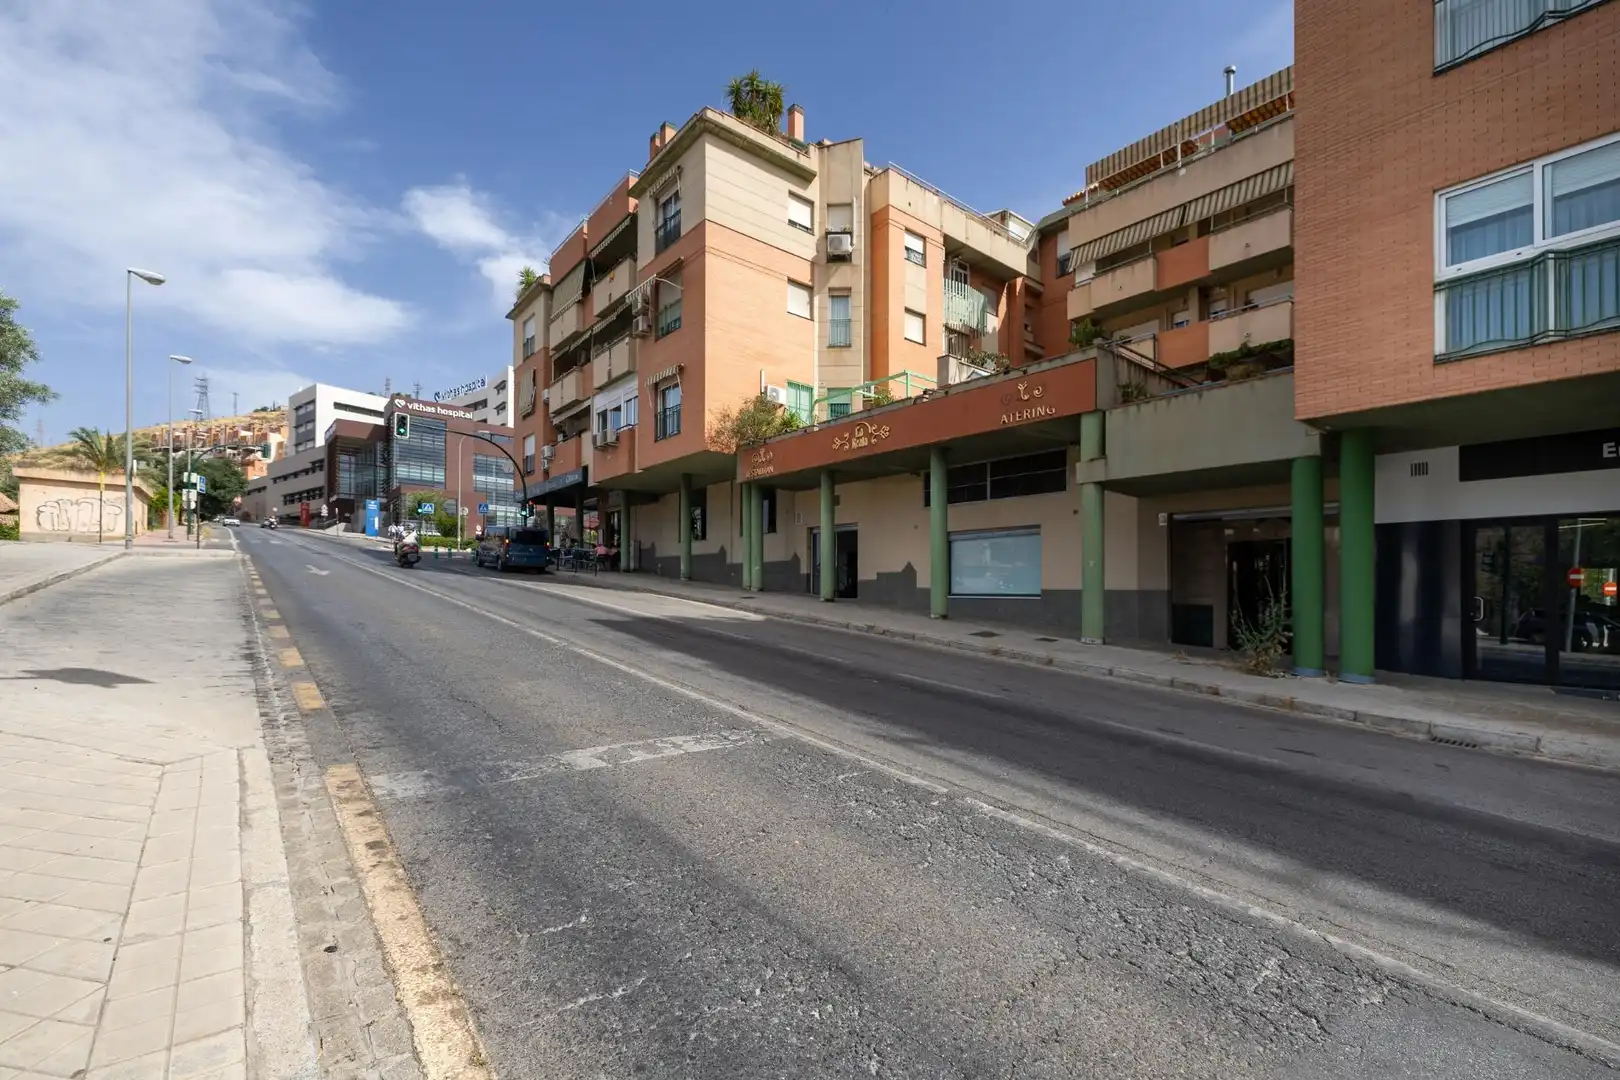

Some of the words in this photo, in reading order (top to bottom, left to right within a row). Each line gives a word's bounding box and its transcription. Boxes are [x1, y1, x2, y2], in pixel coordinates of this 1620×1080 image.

[460, 374, 487, 395] hospital
[407, 402, 436, 413] vithas
[437, 406, 473, 419] hospital
